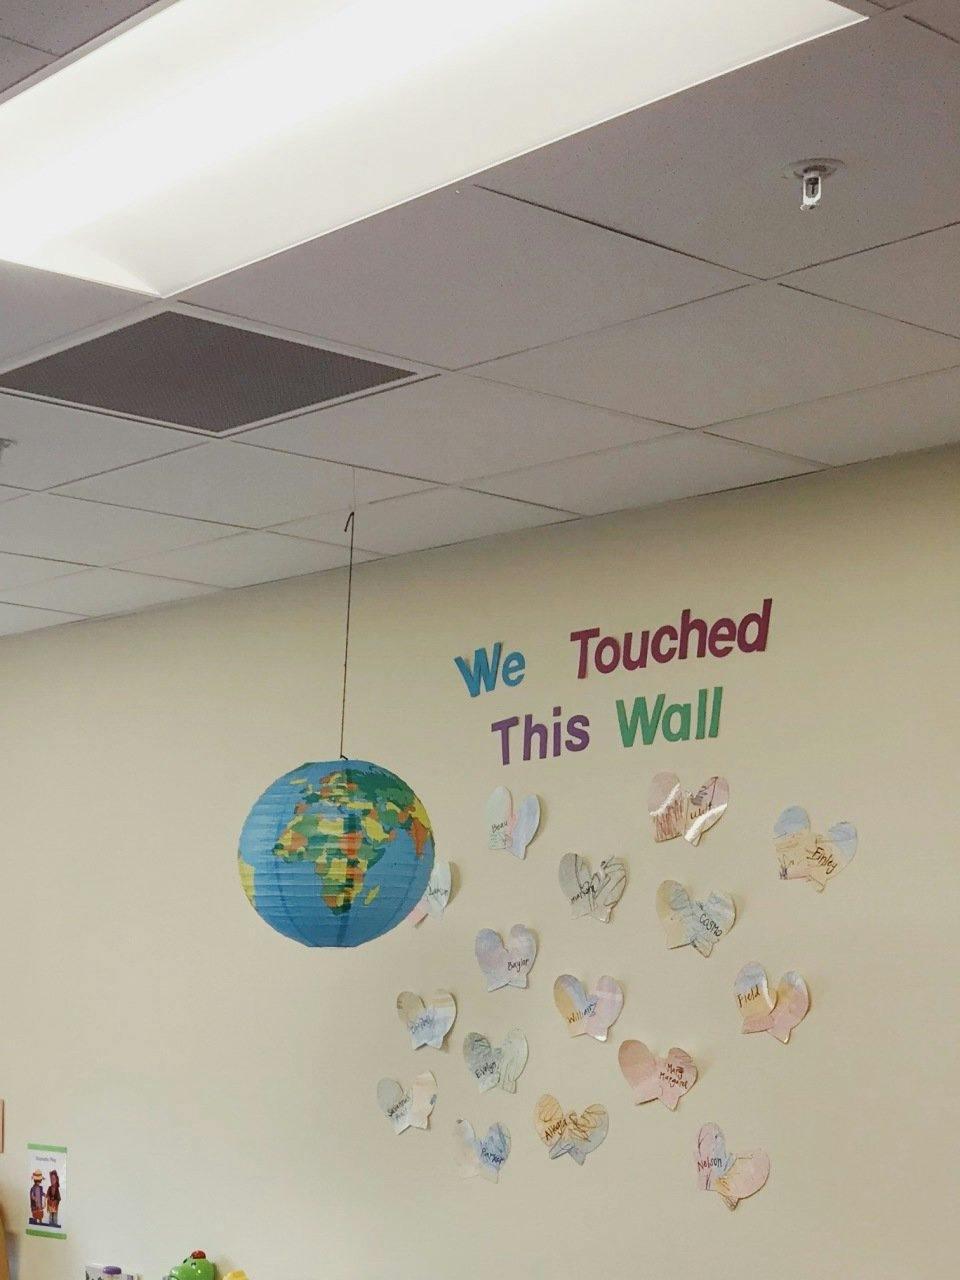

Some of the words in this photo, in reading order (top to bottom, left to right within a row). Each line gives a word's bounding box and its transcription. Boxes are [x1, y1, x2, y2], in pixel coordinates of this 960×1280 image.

[454, 642, 526, 698] We
[570, 598, 773, 680] Touched
[491, 706, 590, 766] This
[616, 687, 723, 748] Wall
[811, 847, 838, 875] Finley
[736, 984, 761, 1008] Field
[696, 1156, 722, 1172] Nelson
